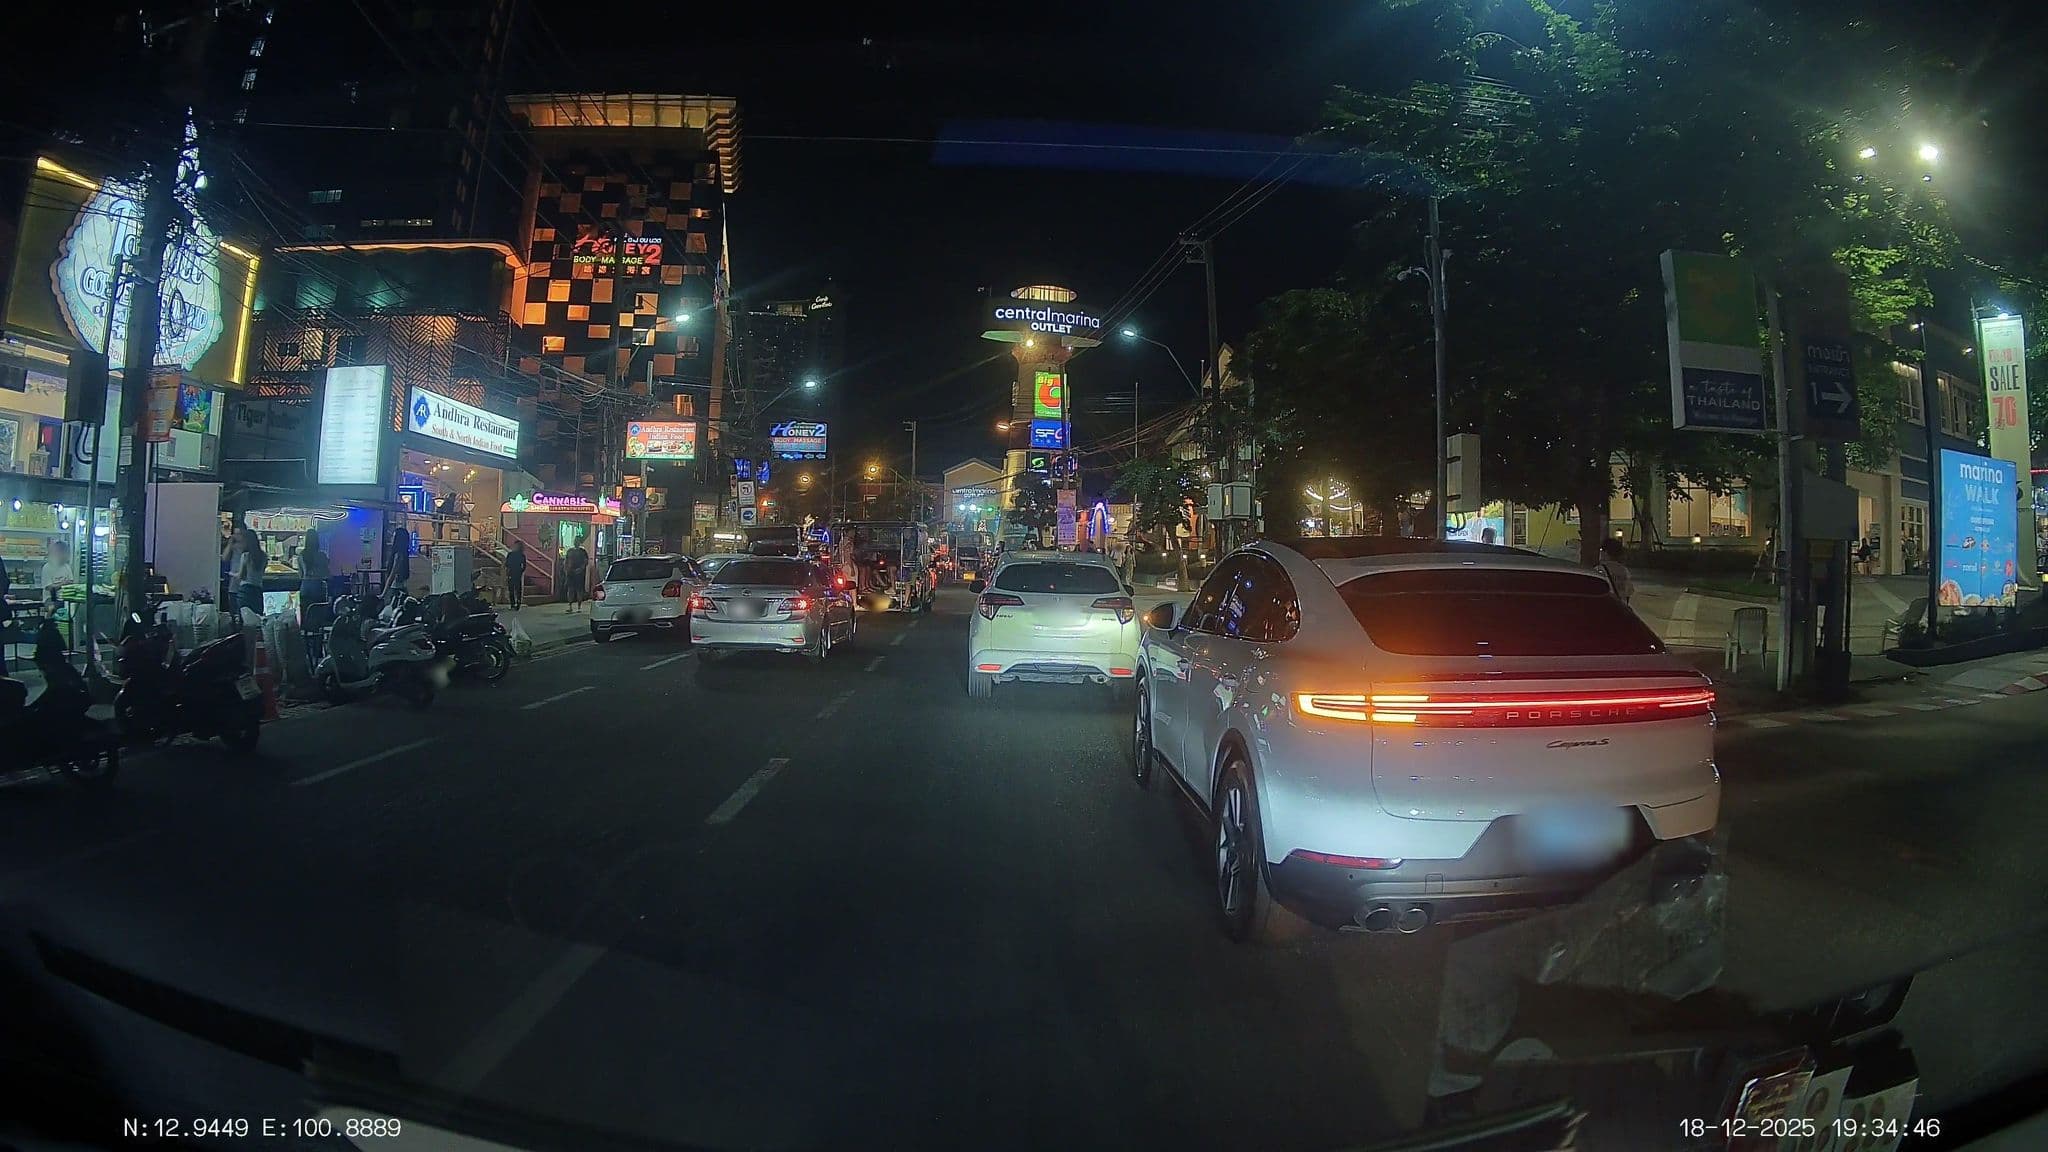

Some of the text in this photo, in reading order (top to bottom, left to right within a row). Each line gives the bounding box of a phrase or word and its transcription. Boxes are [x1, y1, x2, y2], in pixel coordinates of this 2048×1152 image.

[574, 256, 596, 264] BODY
[995, 307, 1100, 328] centralmarina
[1031, 322, 1072, 334] OUTLET
[1038, 375, 1054, 386] Big
[1990, 364, 2020, 391] SALE
[1687, 395, 1761, 411] THAILAND
[434, 402, 516, 440] Andhra Restaurant
[1960, 462, 2003, 484] marina
[1965, 484, 2000, 504] WALK
[1506, 708, 1636, 720] PORSCHE
